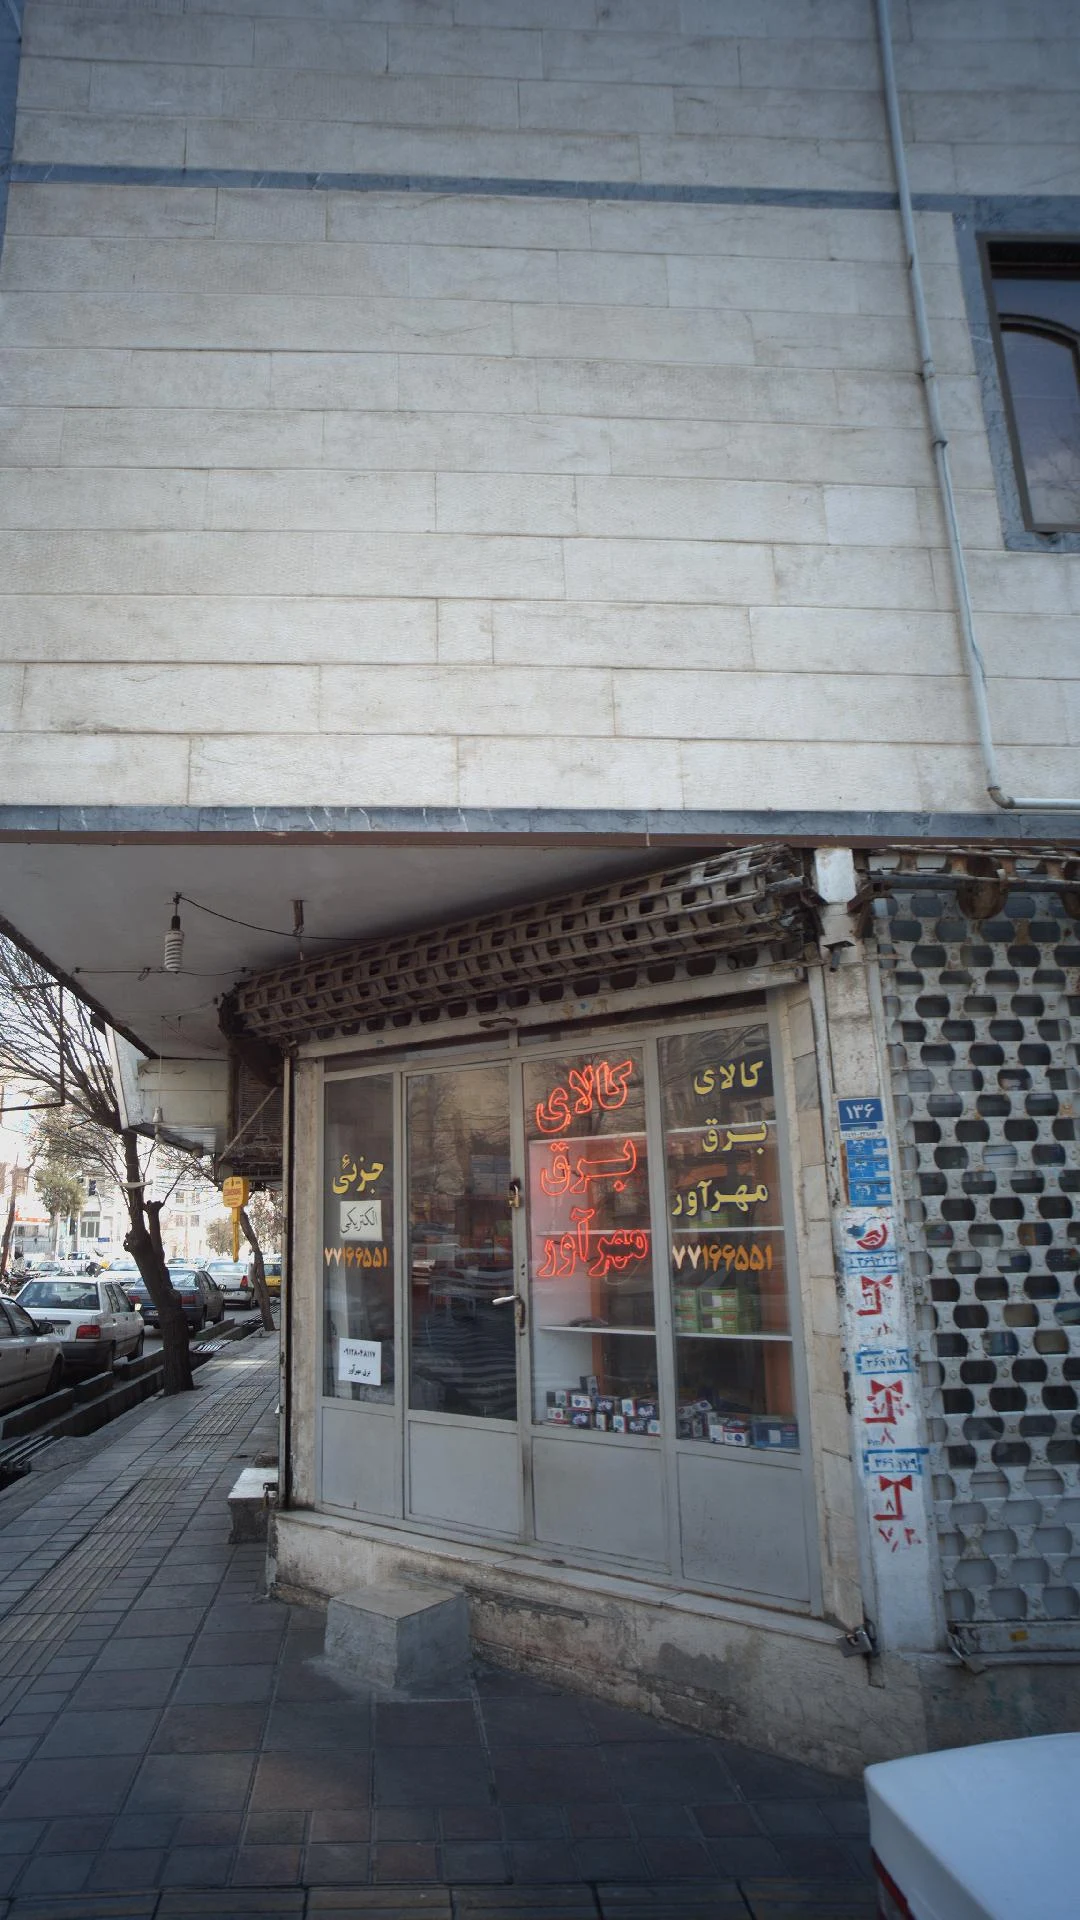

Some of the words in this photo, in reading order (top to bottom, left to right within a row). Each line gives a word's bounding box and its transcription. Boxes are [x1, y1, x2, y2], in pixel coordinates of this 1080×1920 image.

[693, 1060, 764, 1095] کالای
[537, 1060, 632, 1133] کالای
[702, 1117, 768, 1155] برق
[541, 1139, 637, 1196] برق
[324, 1246, 388, 1268] ۷۷۱۶۶۵۵۱
[672, 1244, 773, 1273] ۷۷۱۶۶۵۵۱
